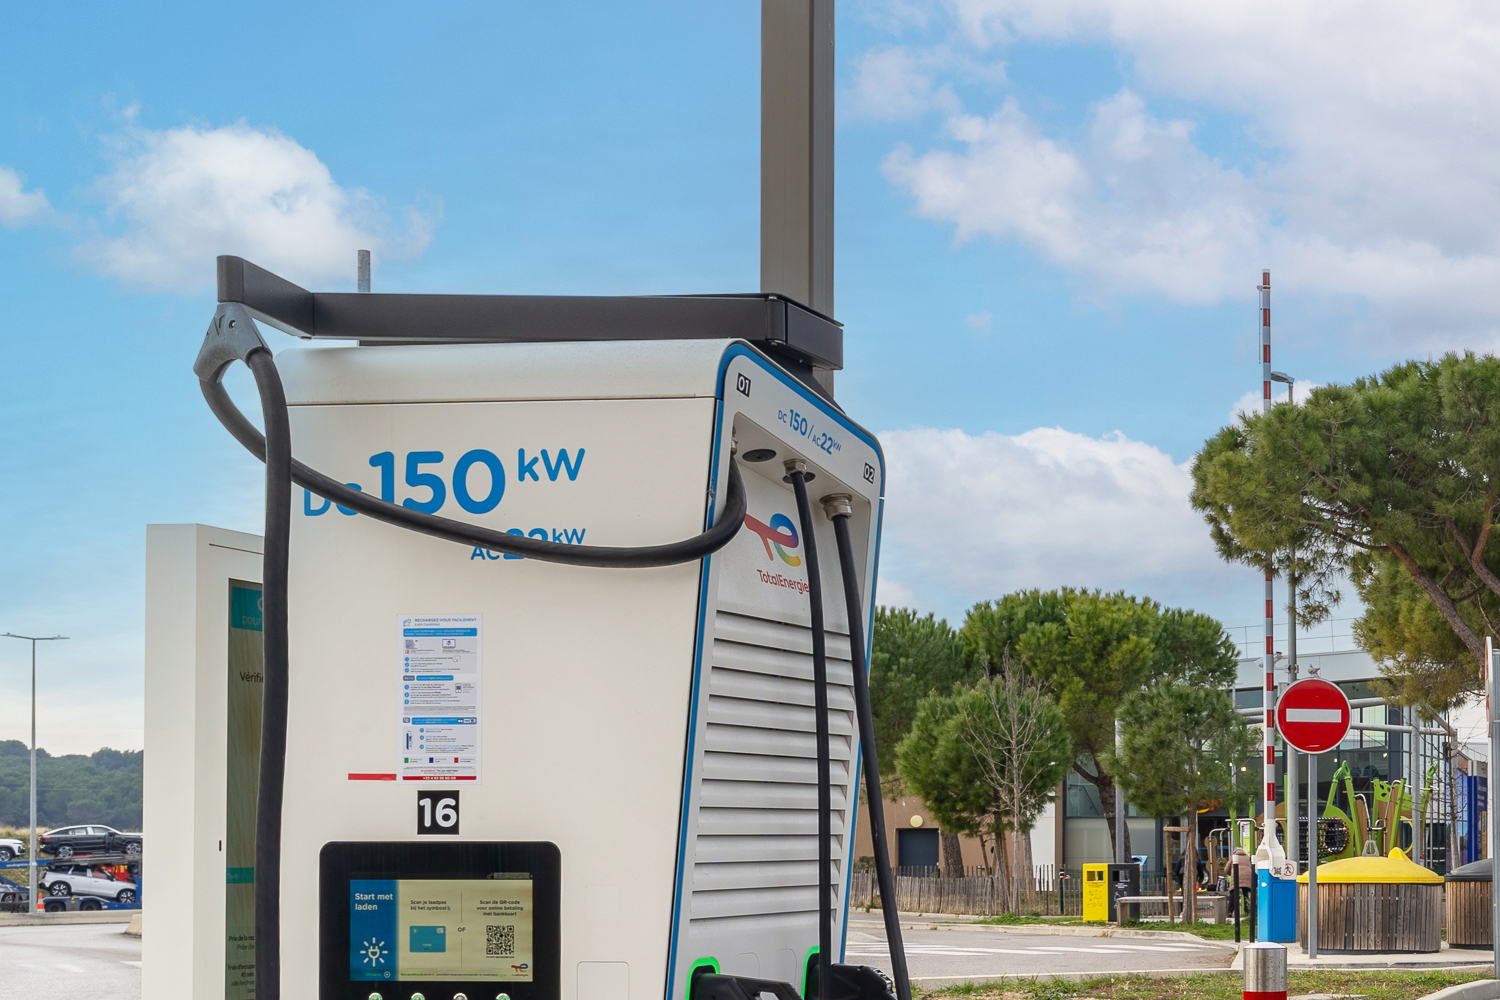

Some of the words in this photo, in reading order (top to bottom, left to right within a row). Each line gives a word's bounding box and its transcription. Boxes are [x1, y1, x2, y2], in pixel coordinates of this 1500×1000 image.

[738, 377, 750, 395] 01
[777, 409, 788, 425] DC
[788, 408, 808, 437] 150
[812, 433, 821, 448] AC
[820, 432, 833, 456] 22
[368, 448, 506, 515] 150
[517, 447, 586, 483] kW
[863, 463, 875, 483] 02
[552, 528, 586, 545] kW
[756, 569, 810, 595] TotalEnergie
[418, 797, 458, 828] 16
[355, 892, 375, 901] Start
[377, 893, 394, 901] met
[355, 903, 378, 911] laden
